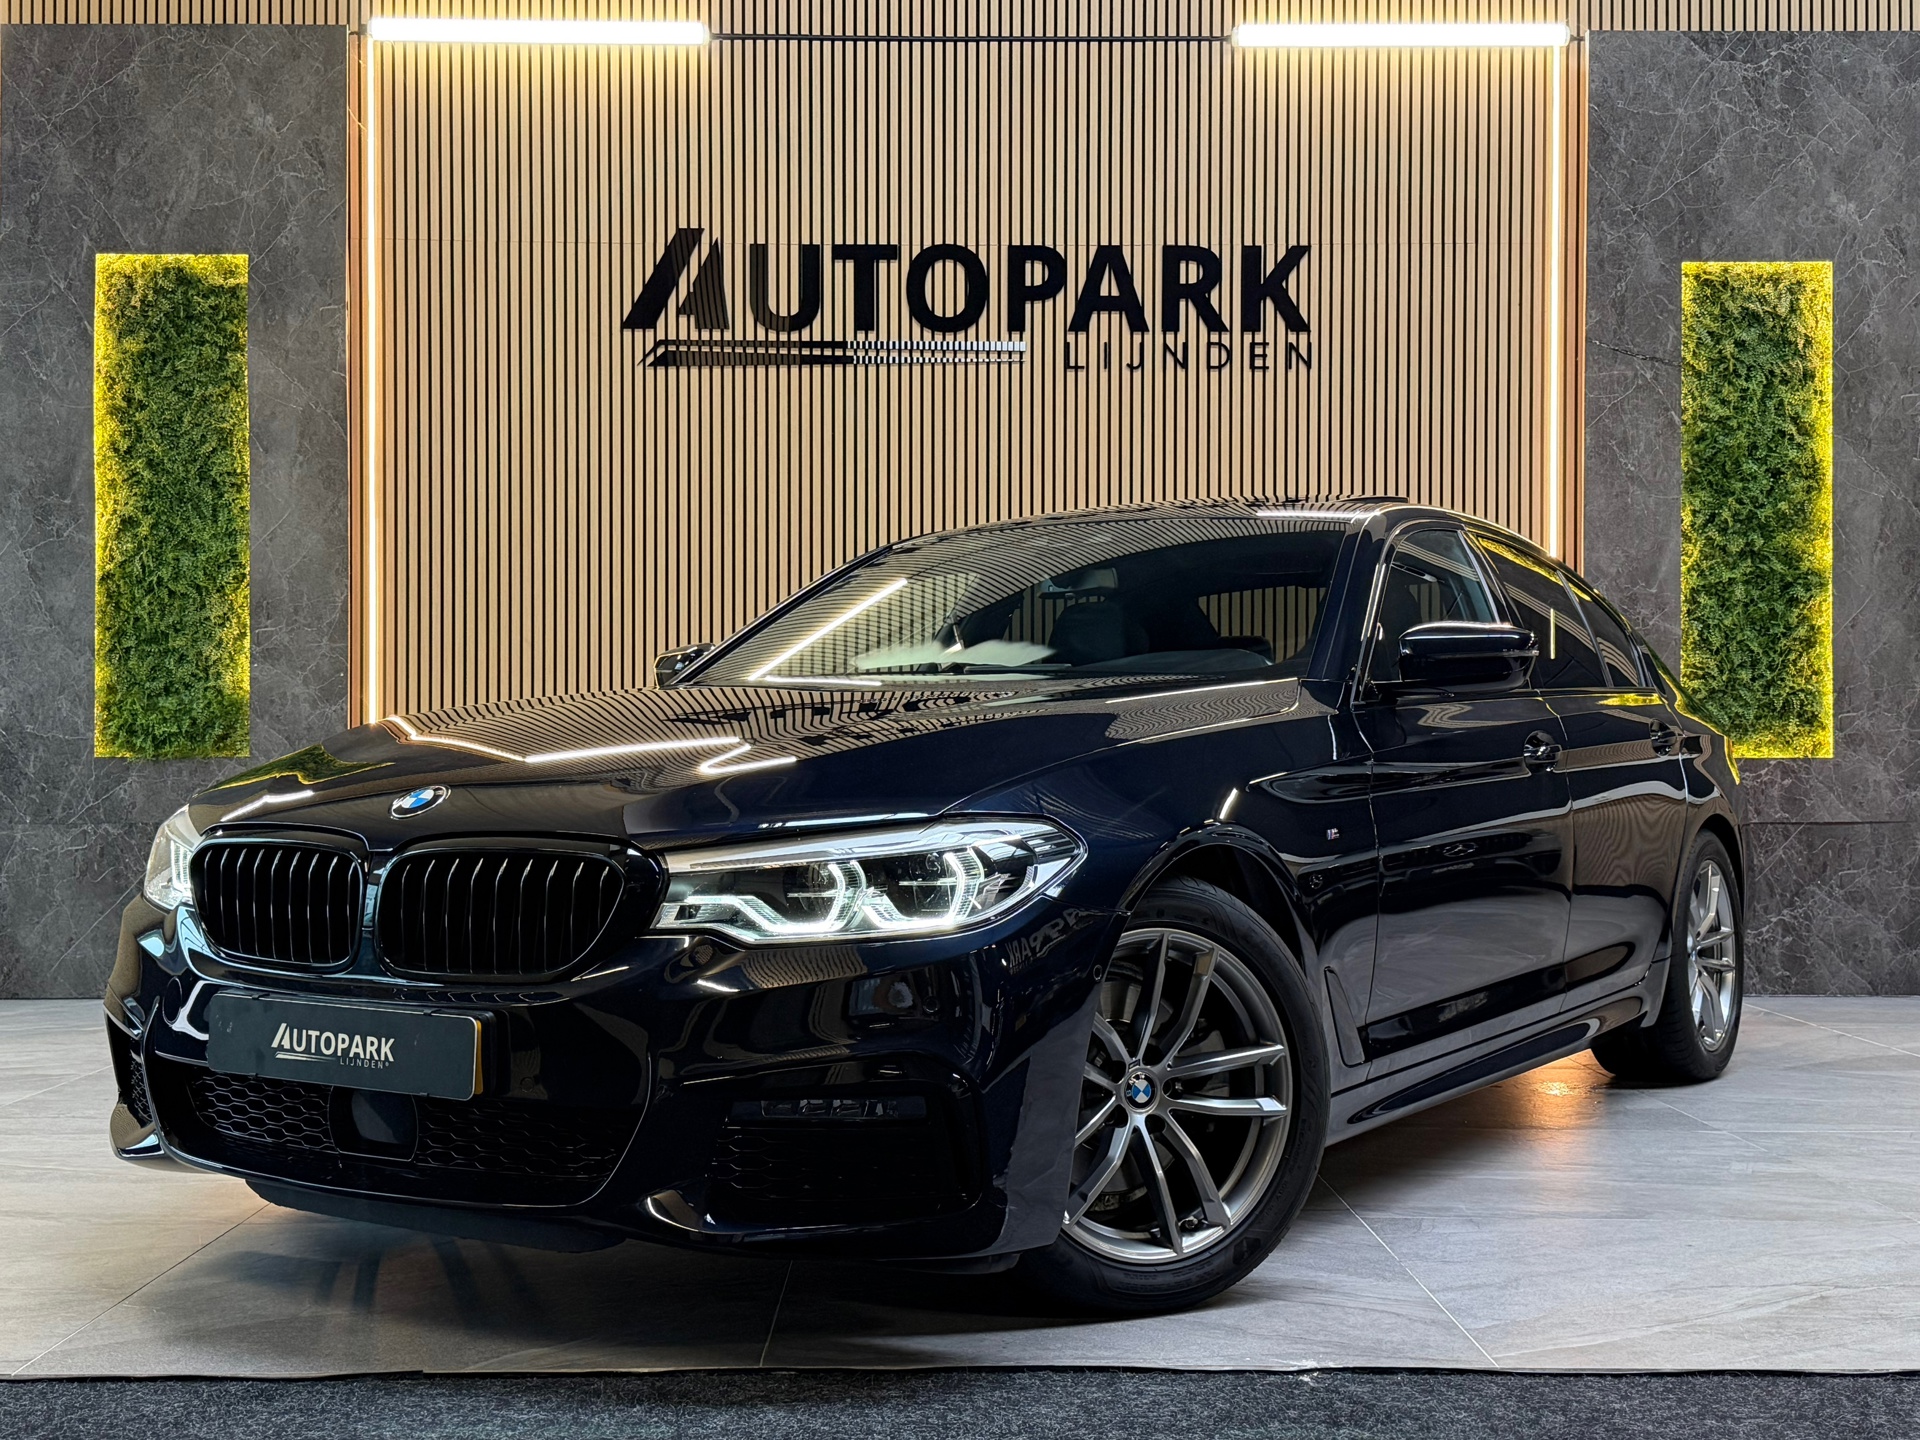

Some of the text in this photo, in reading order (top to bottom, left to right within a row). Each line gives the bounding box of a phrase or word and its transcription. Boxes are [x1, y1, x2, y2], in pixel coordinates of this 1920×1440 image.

[623, 227, 1311, 334] AUTOPARK
[1065, 341, 1312, 371] LIJNDEN
[271, 1022, 395, 1061] AUTOPARK
